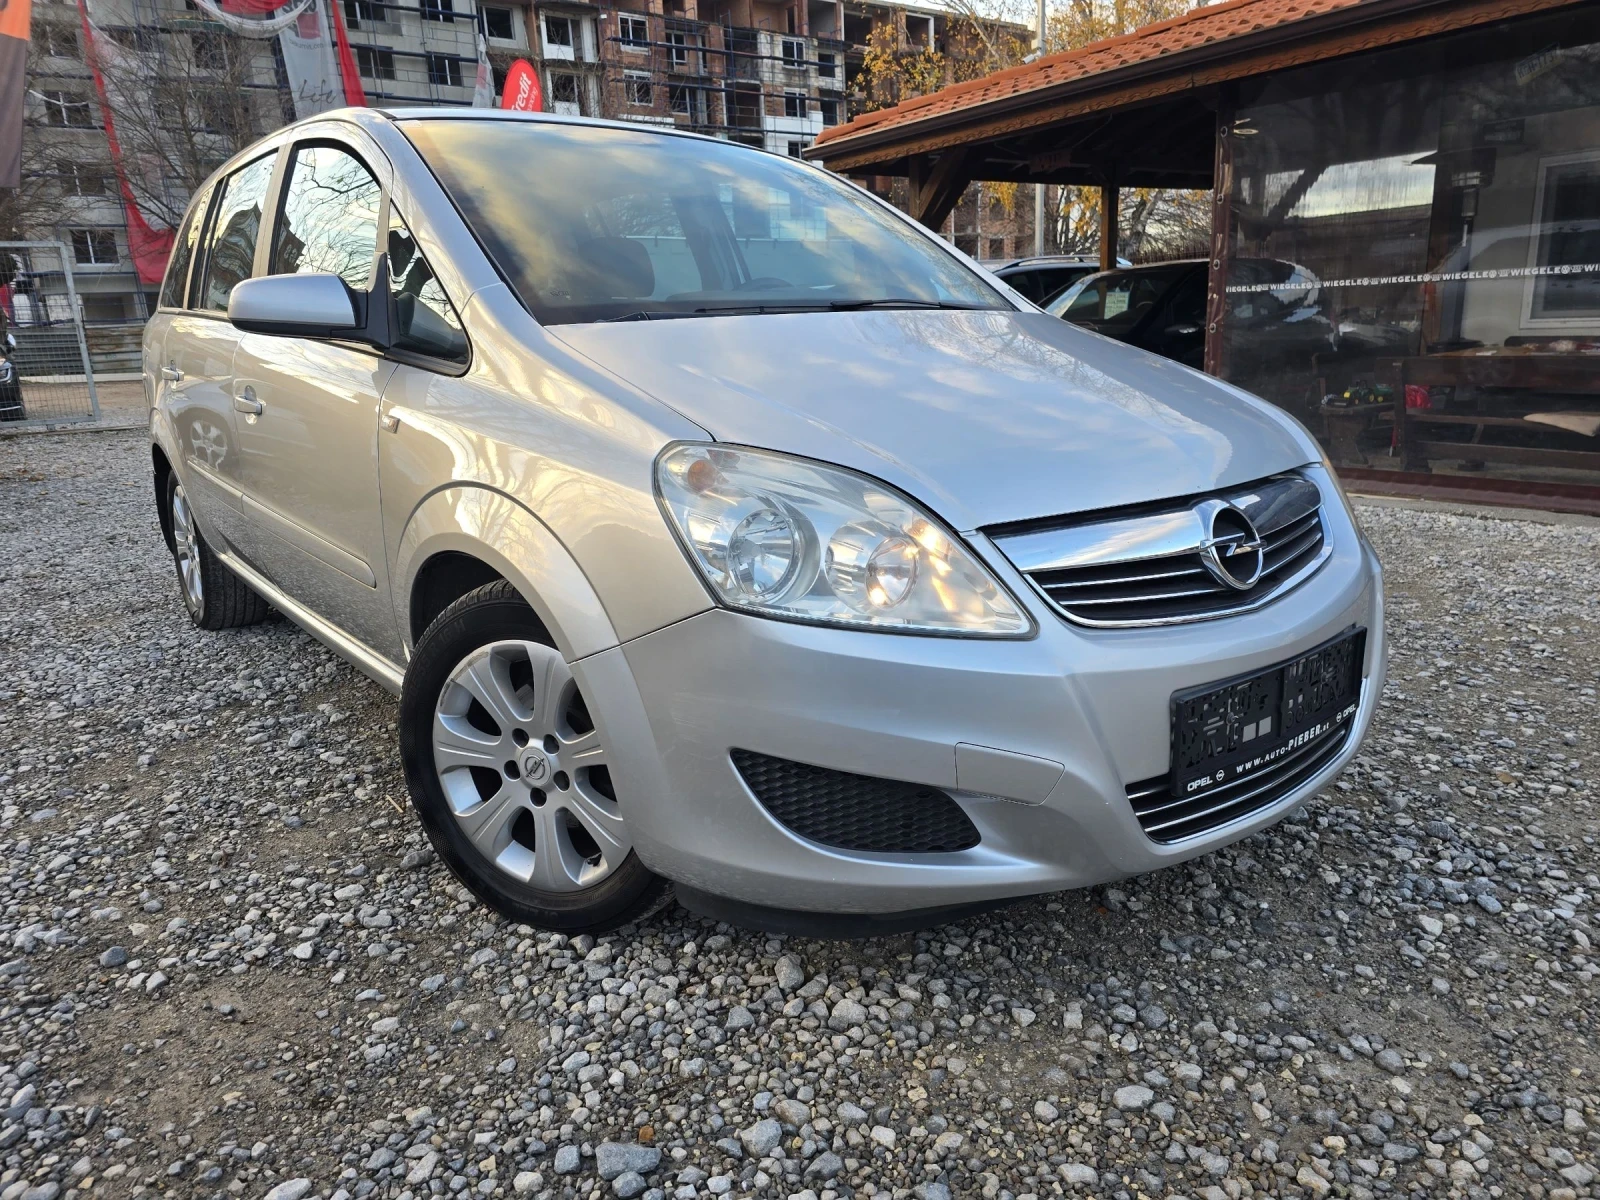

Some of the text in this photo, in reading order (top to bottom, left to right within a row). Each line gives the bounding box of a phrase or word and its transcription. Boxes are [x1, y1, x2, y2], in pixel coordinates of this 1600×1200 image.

[1270, 282, 1307, 290] WIEGELE
[1323, 278, 1362, 287] WIEGELE
[1380, 274, 1423, 284] WIEGELE
[1442, 271, 1489, 280] WIEGELE
[1510, 266, 1560, 276] WIEGELE
[1187, 775, 1213, 792] OPEL
[1342, 703, 1356, 718] OPEL
